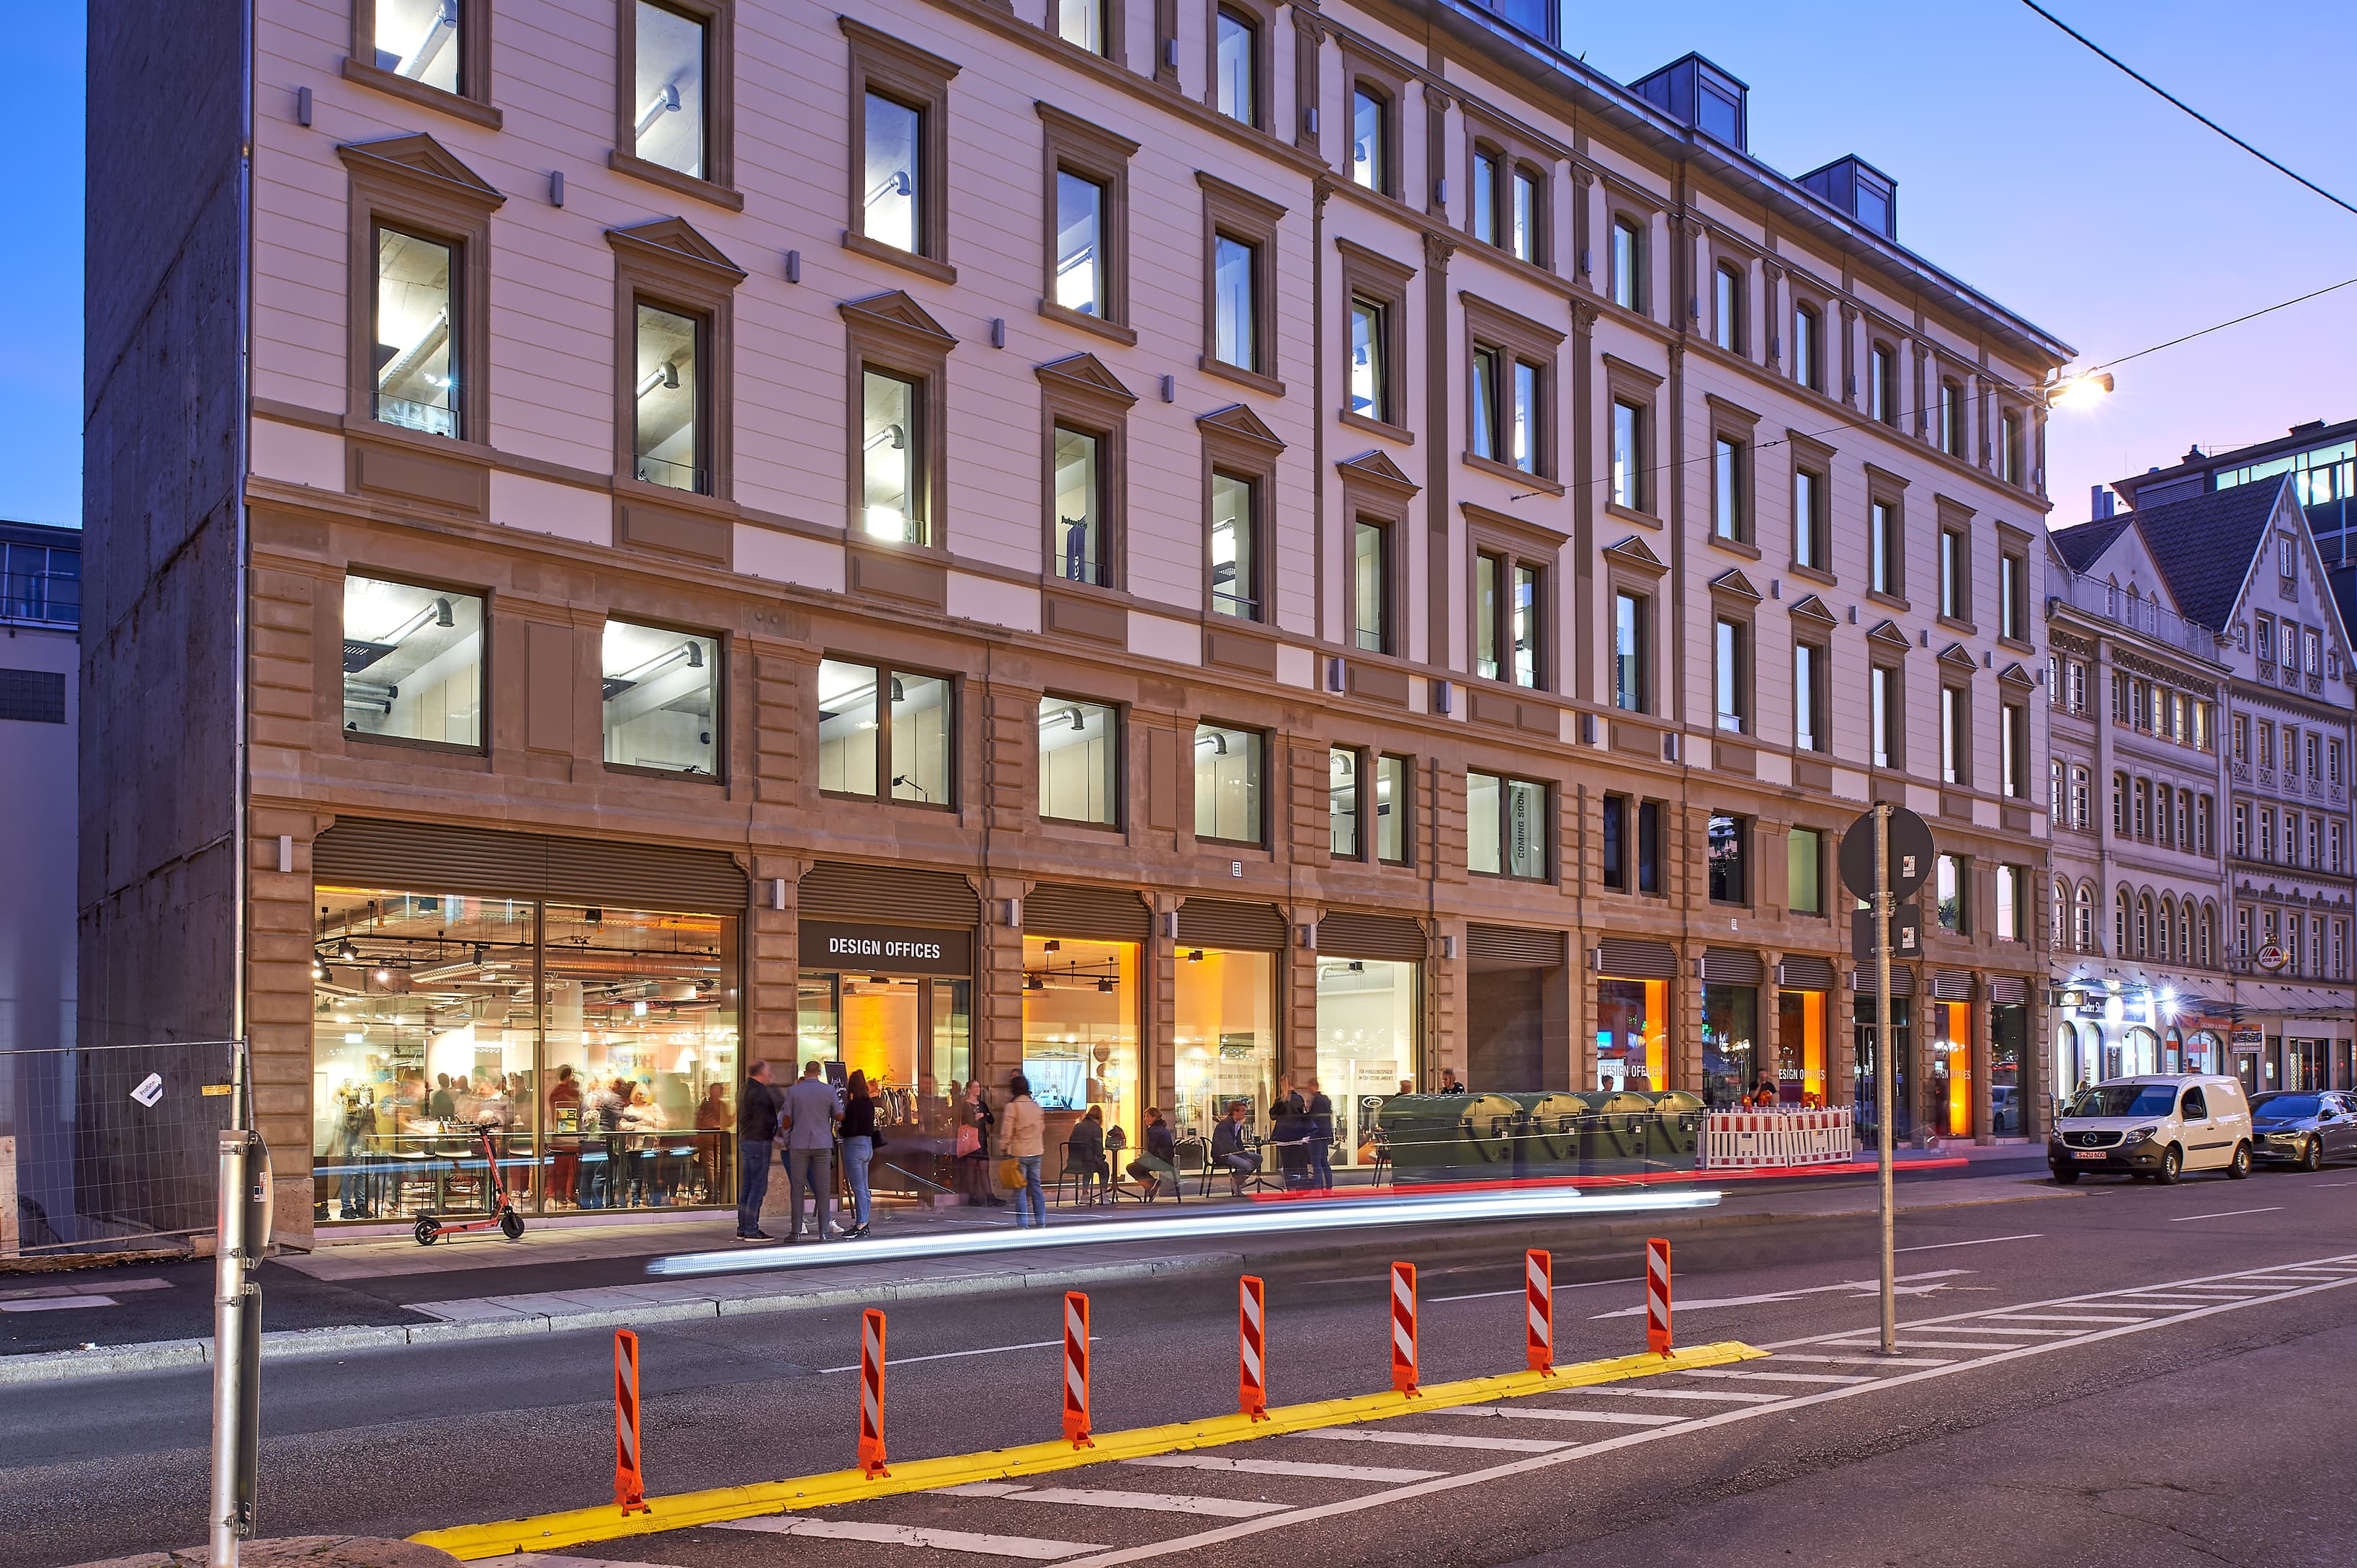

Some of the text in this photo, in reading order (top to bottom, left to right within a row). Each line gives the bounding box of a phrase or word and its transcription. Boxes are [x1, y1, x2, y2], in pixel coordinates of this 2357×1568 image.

[829, 938, 941, 959] DESIGN OFFICES
[1600, 1065, 1629, 1078] DESIGN
[1779, 1068, 1798, 1080] ESIGN
[1936, 1069, 1949, 1079] SIGN
